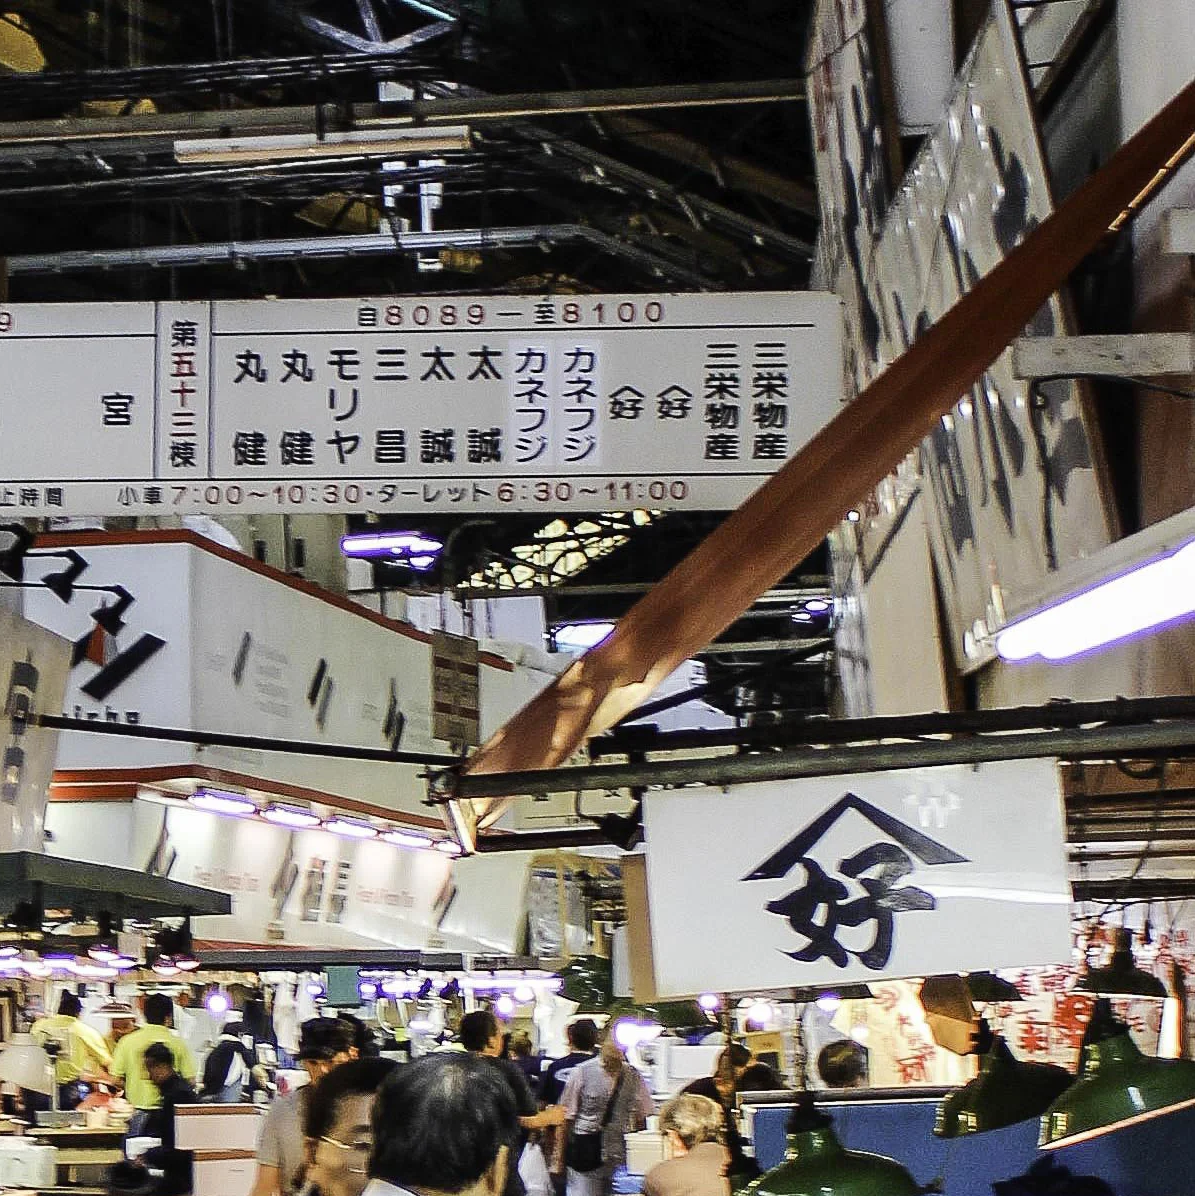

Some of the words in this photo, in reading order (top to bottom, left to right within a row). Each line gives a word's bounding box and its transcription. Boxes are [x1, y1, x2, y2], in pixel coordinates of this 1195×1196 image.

[169, 320, 198, 468] 第五十三棟
[326, 349, 360, 464] モリヤ
[514, 347, 549, 463] カネフジ
[562, 347, 597, 463] カネフジ
[705, 343, 740, 460] 三栄物産
[752, 342, 788, 459] 三栄物産
